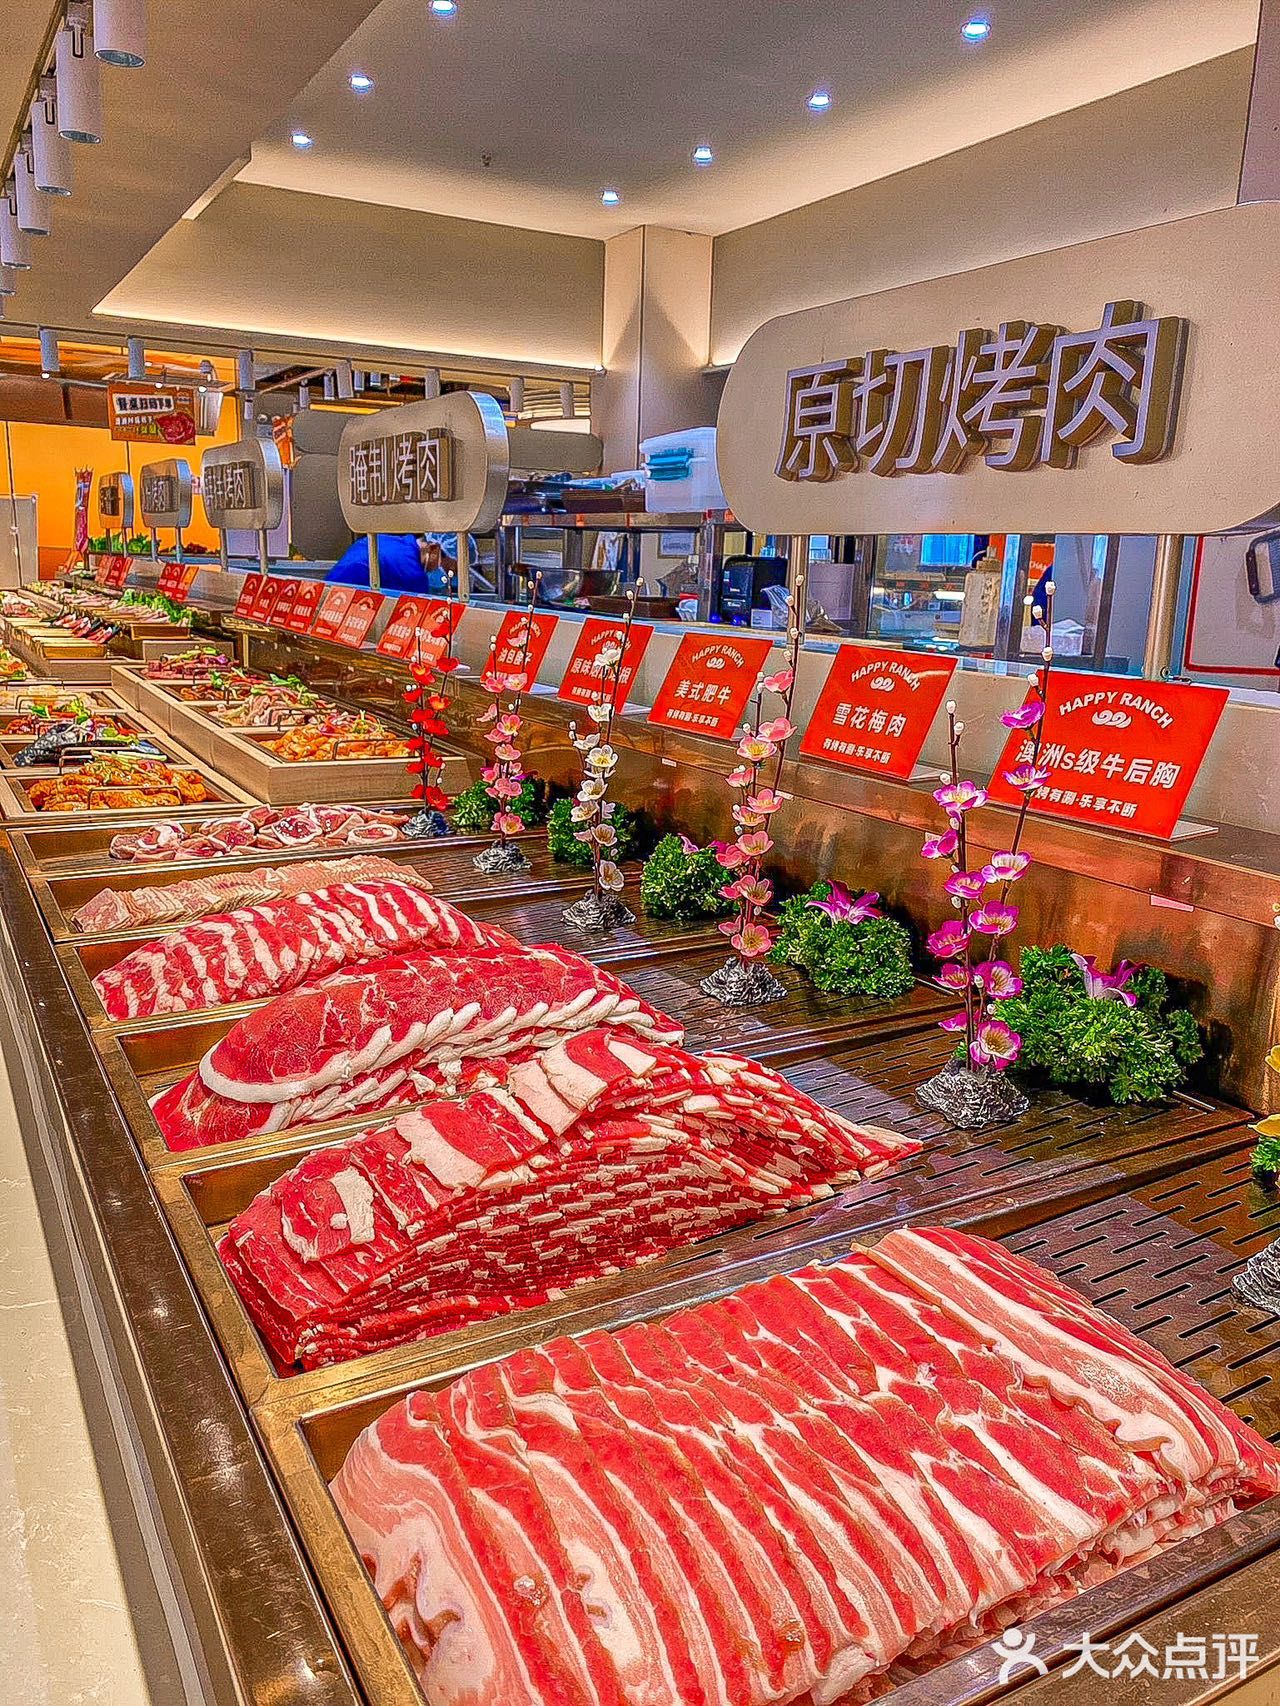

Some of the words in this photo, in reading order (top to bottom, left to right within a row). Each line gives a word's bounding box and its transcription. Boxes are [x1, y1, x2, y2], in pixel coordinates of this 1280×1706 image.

[775, 300, 1190, 482] 原切烤肉
[349, 428, 449, 505] 腌制烤肉
[691, 644, 722, 663] HAPPY
[721, 644, 745, 668] RANCH
[673, 679, 732, 706] 美式肥牛
[851, 660, 889, 683] HAPPY
[888, 661, 921, 692] RANCH
[832, 702, 907, 738] 雪花梅肉
[1058, 691, 1118, 716] HAPPY
[1119, 692, 1174, 729] RANCH
[1028, 784, 1138, 819] 烤有涮·乐享不断
